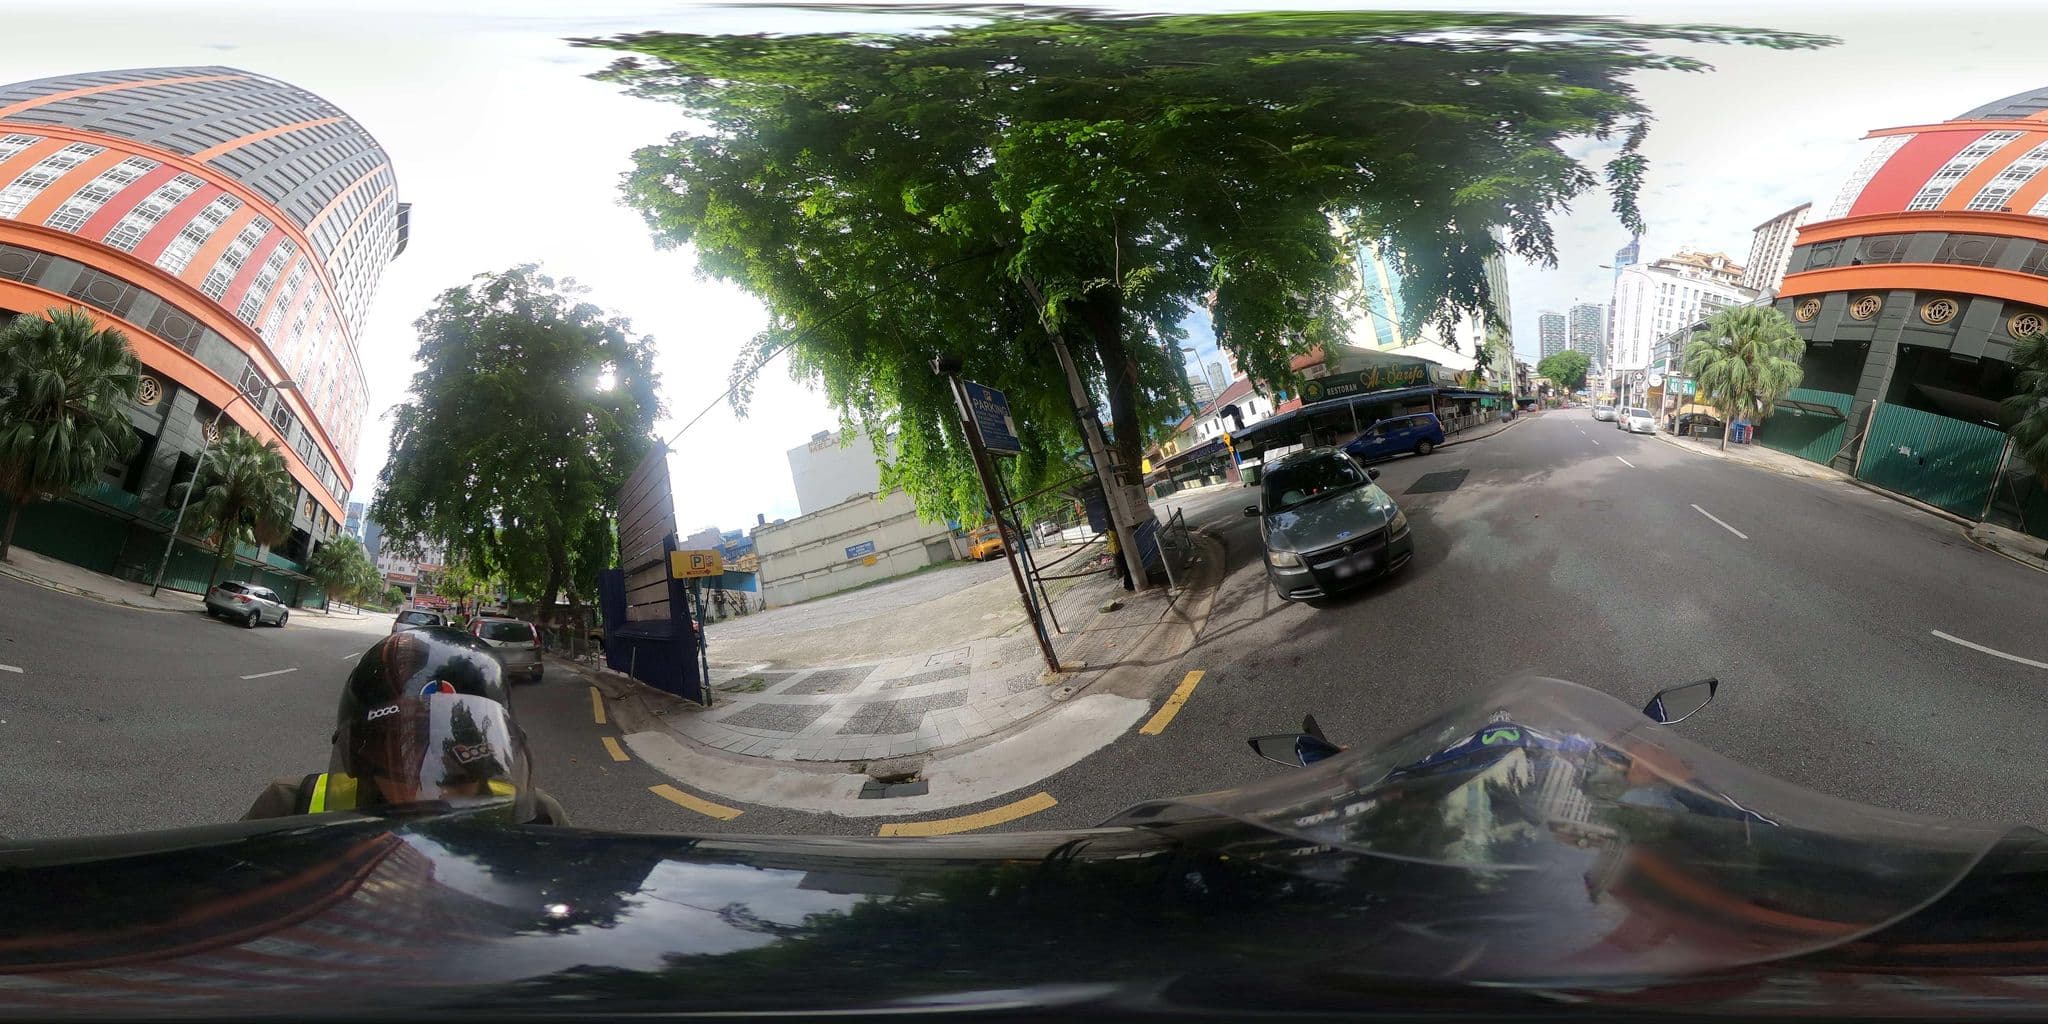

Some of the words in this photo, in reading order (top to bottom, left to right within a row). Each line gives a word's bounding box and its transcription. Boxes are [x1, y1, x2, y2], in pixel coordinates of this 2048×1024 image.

[1326, 383, 1358, 396] RESTORAN
[972, 398, 1009, 417] PARKING
[693, 556, 702, 568] P
